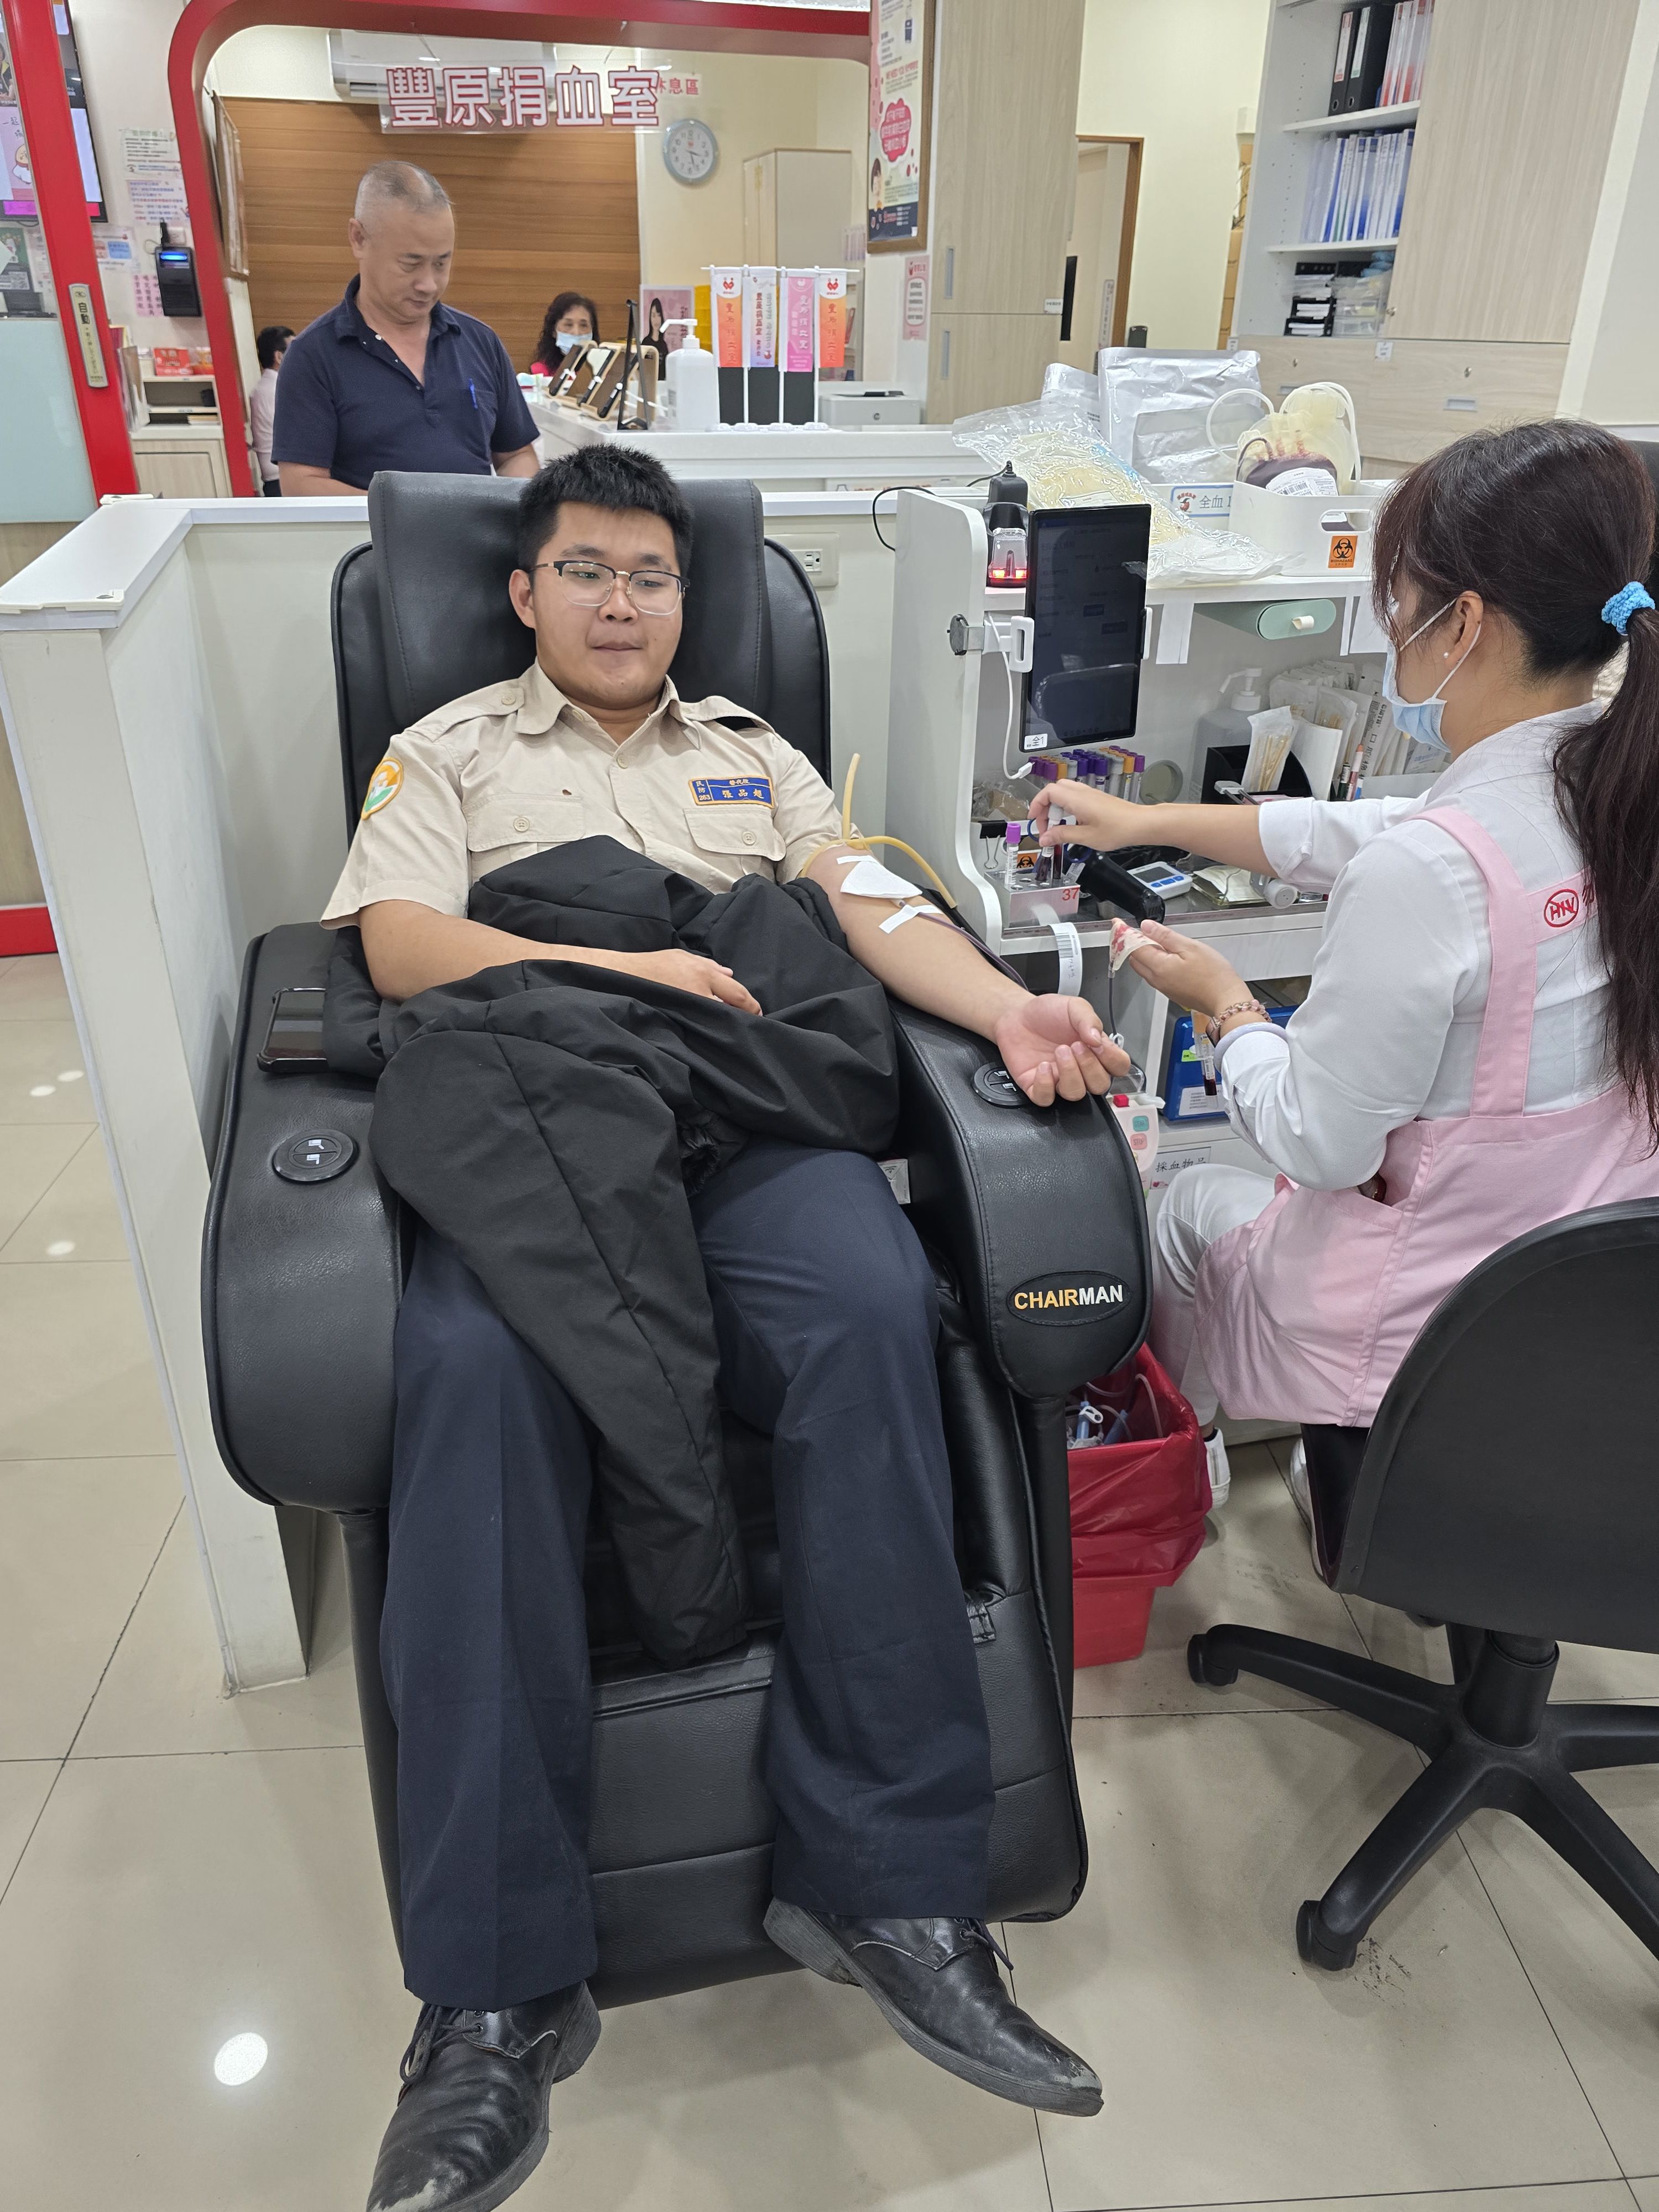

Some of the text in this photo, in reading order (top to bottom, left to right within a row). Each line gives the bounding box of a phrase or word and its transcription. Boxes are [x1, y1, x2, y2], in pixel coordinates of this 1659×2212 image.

[385, 65, 660, 128] 豐原捐血室
[1199, 495, 1223, 508] 全血
[1062, 888, 1079, 901] 37
[1014, 1285, 1123, 1310] CHAIRMAN
